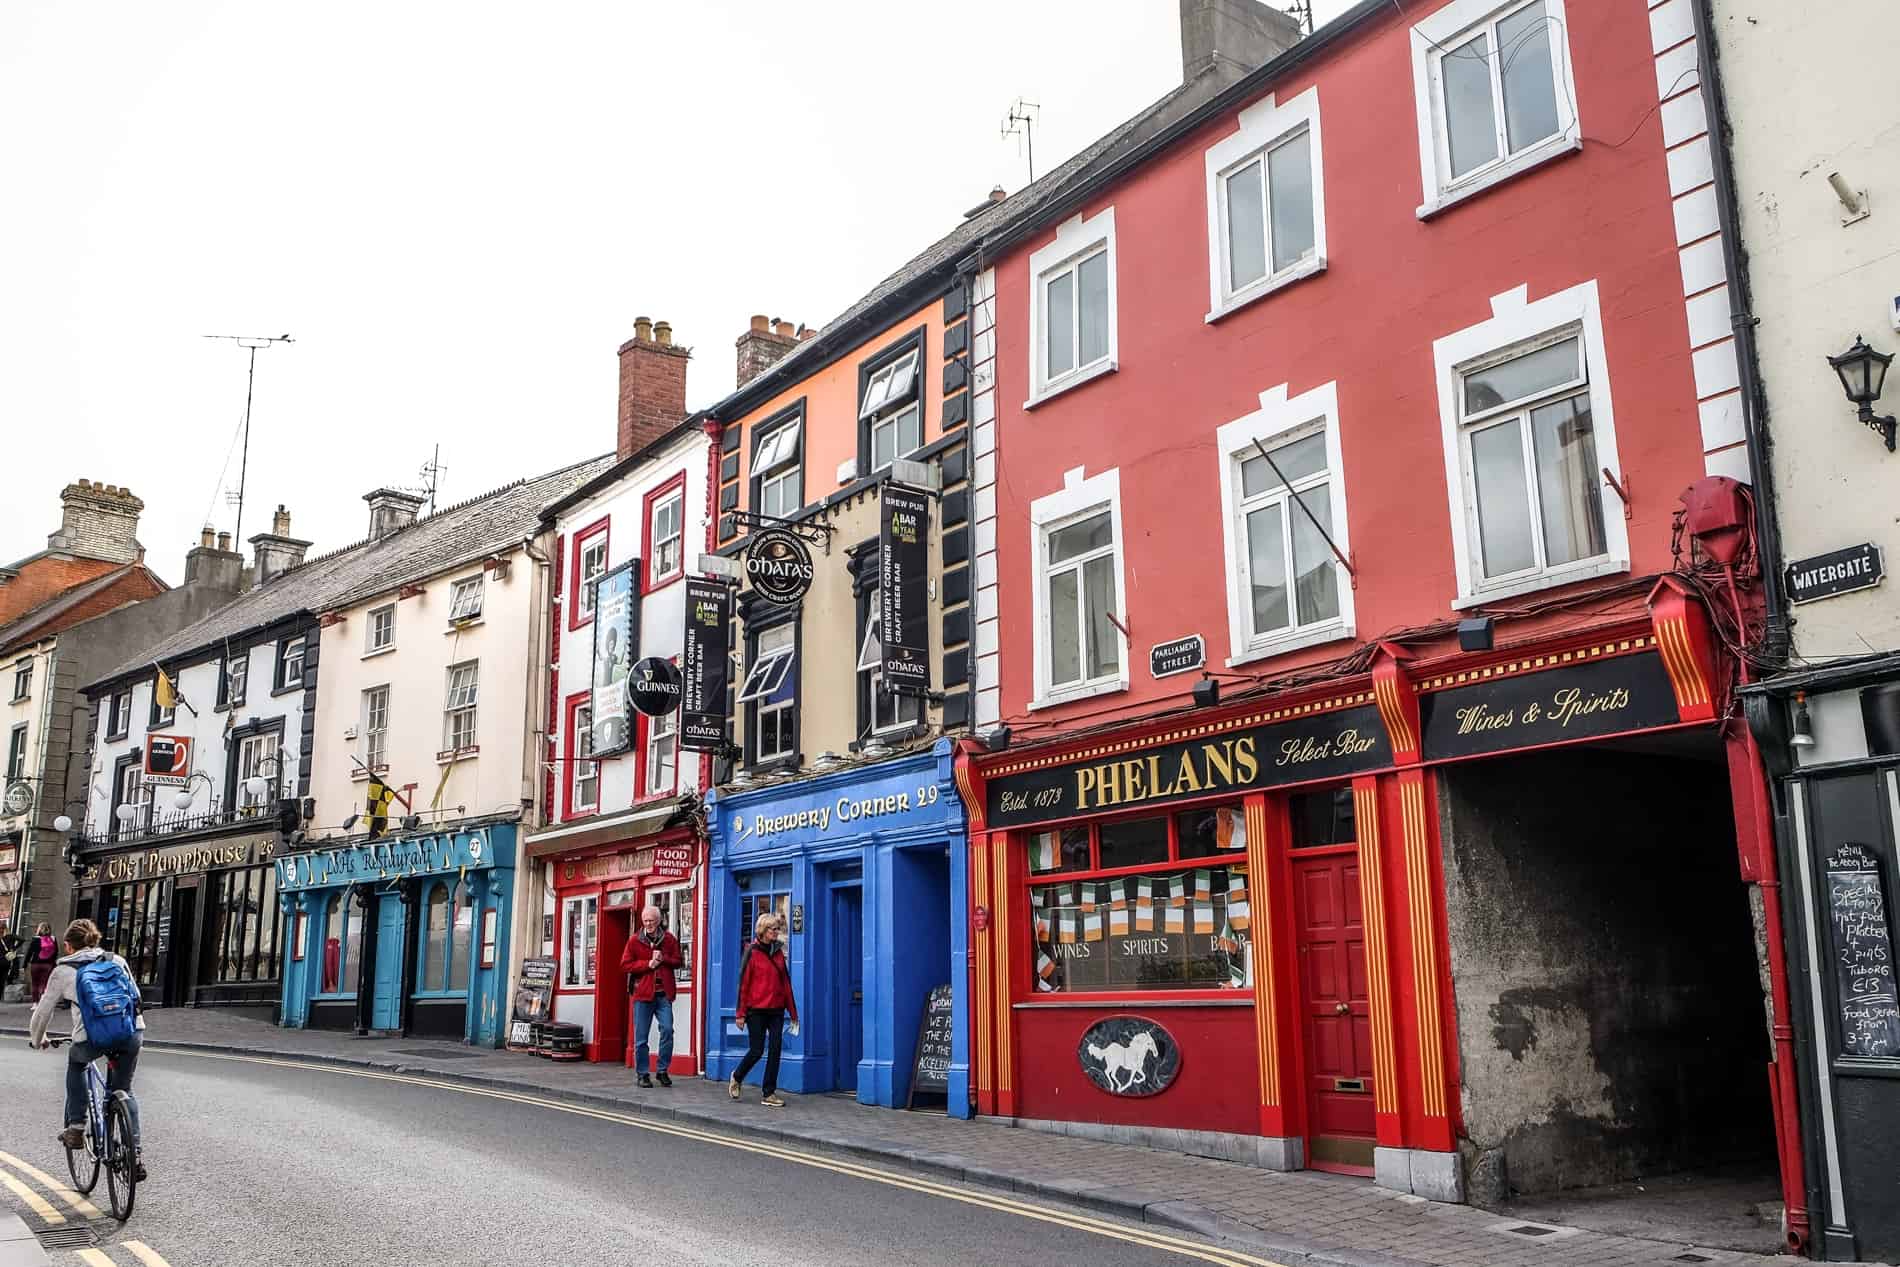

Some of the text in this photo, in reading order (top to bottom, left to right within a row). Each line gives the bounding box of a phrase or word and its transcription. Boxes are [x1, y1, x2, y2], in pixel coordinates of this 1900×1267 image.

[1792, 556, 1872, 590] WATERGATE
[1155, 641, 1198, 660] PARLIAMENT
[686, 629, 696, 710] BREWERY CORNER
[1162, 655, 1192, 670] STREET
[637, 681, 680, 695] GUINNESS
[1456, 687, 1631, 735] Wines & Spirits
[1276, 729, 1376, 766] Select Bar
[1074, 736, 1260, 810] PHELANS
[1034, 787, 1063, 808] 1873
[755, 784, 938, 837] Brewery Corner 29
[471, 841, 480, 854] 27
[656, 849, 688, 860] FOOD
[108, 839, 274, 879] The Pumphouse 26
[1053, 942, 1091, 960] WINES
[1122, 937, 1170, 956] SPIRITS
[1841, 947, 1852, 964] 2
[926, 1030, 942, 1041] THE
[936, 1045, 951, 1057] THE
